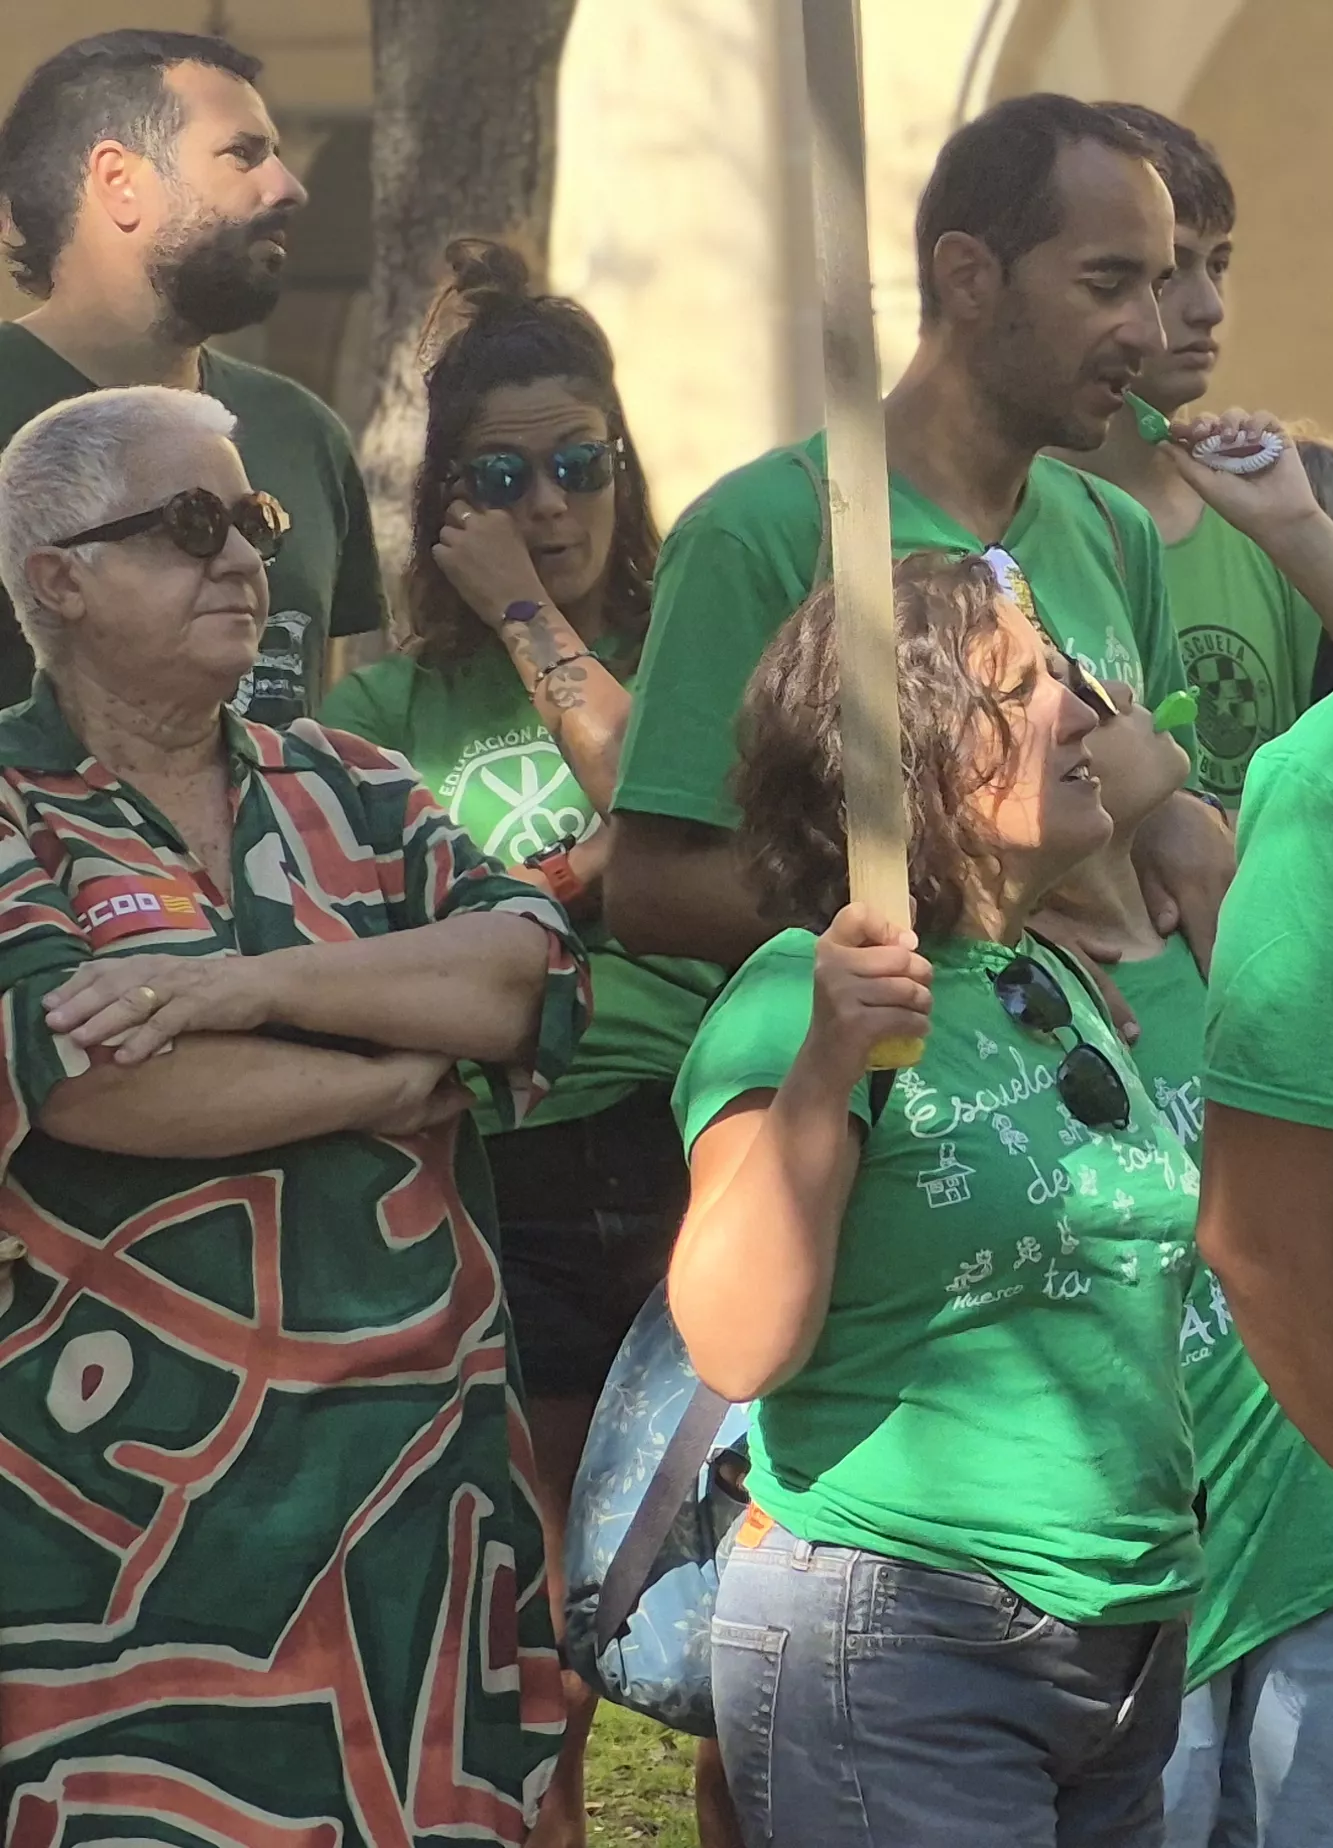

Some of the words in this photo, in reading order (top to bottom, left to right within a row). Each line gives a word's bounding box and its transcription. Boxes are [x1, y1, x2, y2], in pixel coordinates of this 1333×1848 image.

[439, 725, 532, 797] EDUCACIÓN
[905, 1046, 1055, 1138] Escuela
[1028, 1156, 1071, 1205] de
